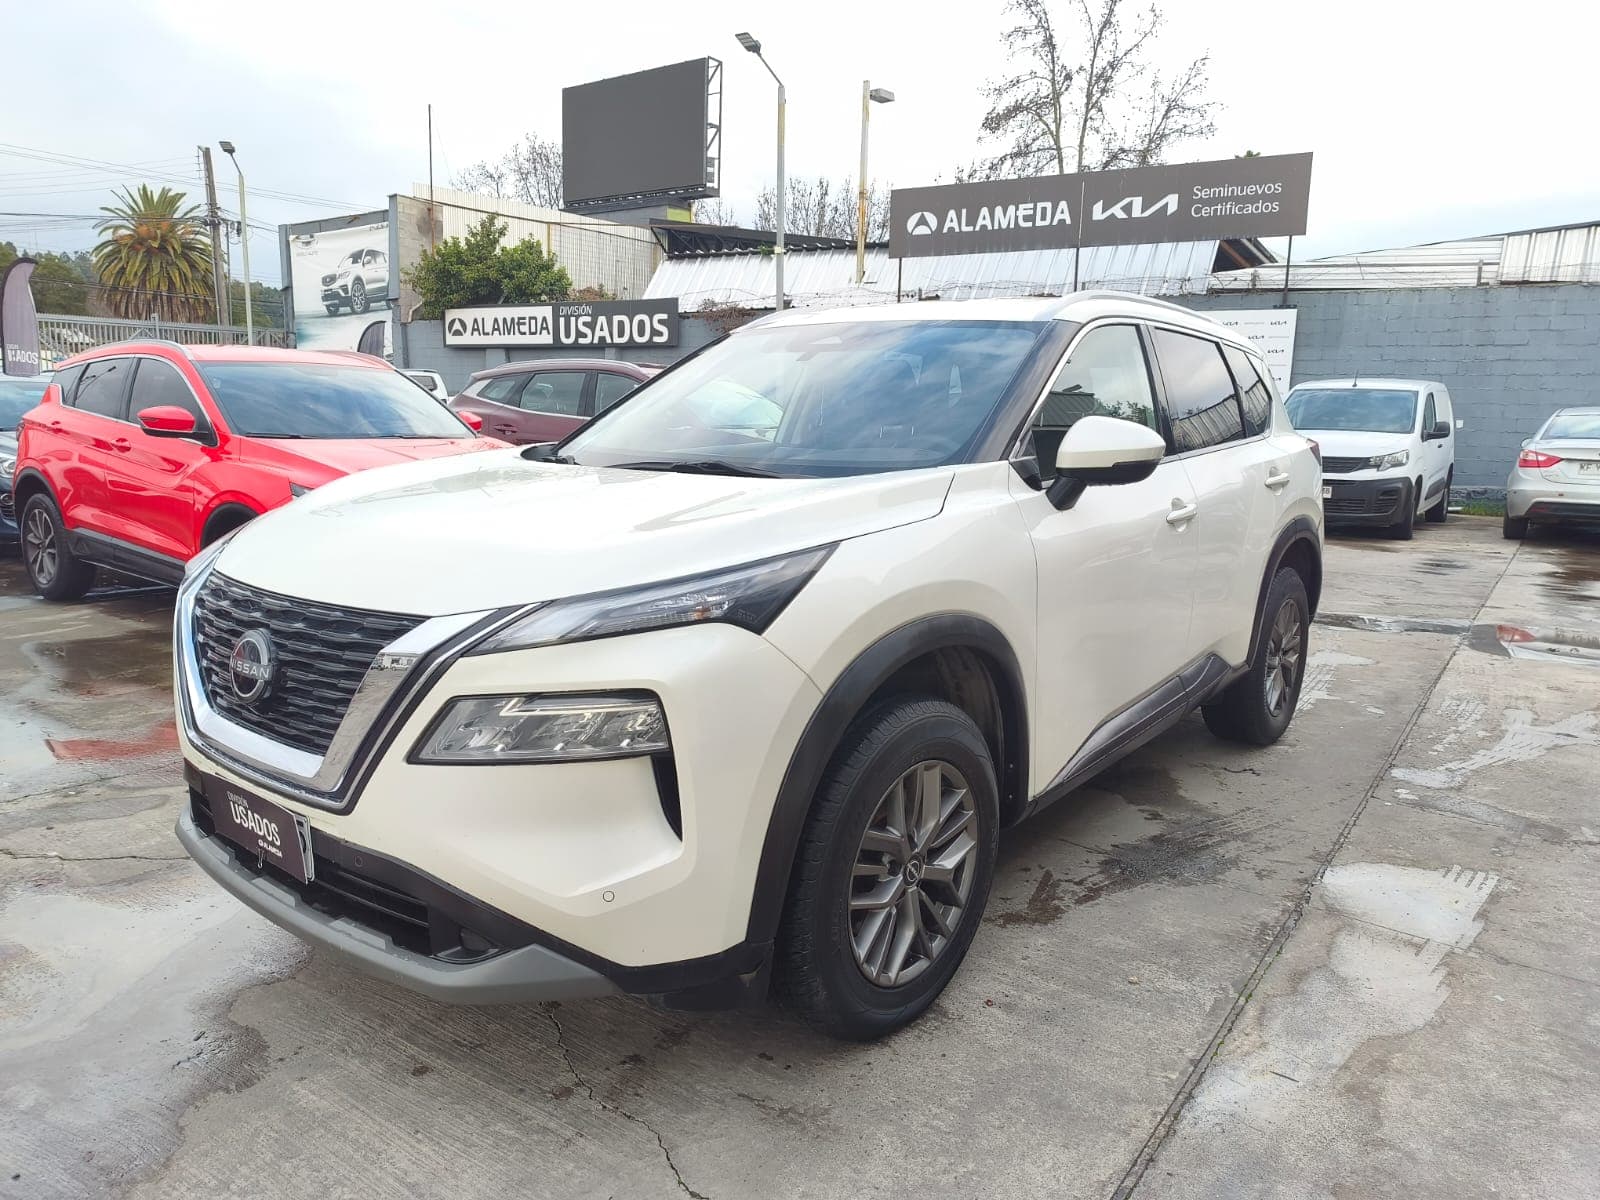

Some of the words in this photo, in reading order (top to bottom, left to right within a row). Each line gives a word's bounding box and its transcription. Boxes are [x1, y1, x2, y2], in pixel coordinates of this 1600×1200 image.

[1192, 182, 1283, 201] Seminuevos
[942, 200, 1072, 235] ALAMEDA
[1092, 193, 1179, 221] KIA
[1191, 199, 1280, 219] Certificados
[559, 303, 593, 316] DIVISIÓN
[470, 315, 551, 337] ALAMEDA
[559, 313, 669, 345] USADOS
[231, 658, 270, 680] NISSAN
[229, 801, 281, 847] USADOS
